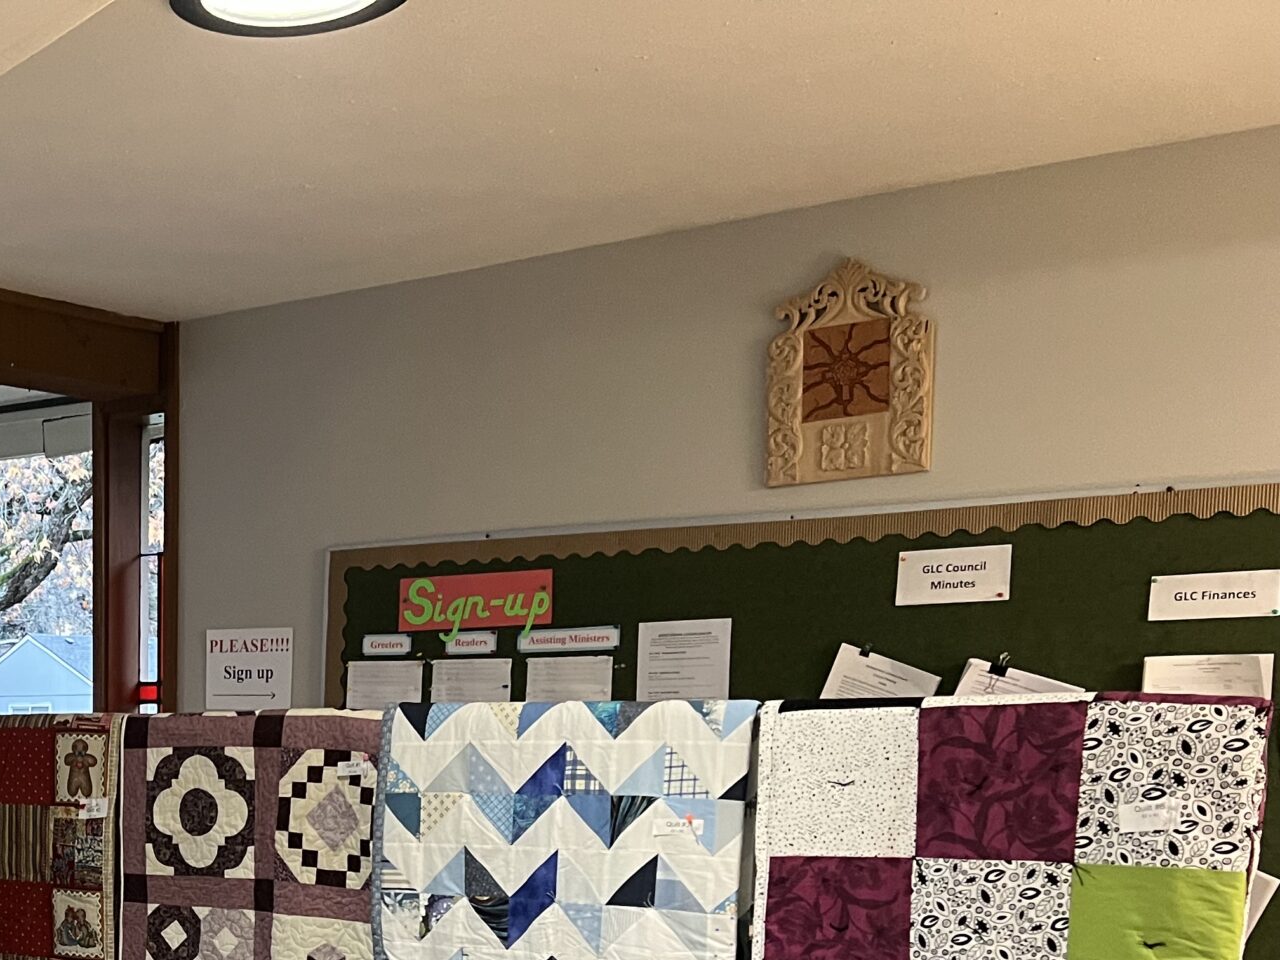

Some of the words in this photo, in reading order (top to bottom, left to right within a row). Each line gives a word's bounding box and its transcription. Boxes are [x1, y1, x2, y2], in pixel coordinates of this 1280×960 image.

[922, 565, 943, 574] GLC
[945, 561, 987, 573] Council
[930, 580, 976, 590] Minutes
[1174, 591, 1198, 602] GLC
[1201, 590, 1257, 600] Finances
[403, 577, 551, 642] Sign-up
[210, 637, 289, 653] PLEASE!!!!
[370, 640, 404, 650] Greeters
[455, 637, 488, 648] Readers
[528, 635, 567, 646] Assisting
[568, 633, 610, 643] Ministers
[223, 665, 252, 683] Sign
[257, 668, 274, 683] up
